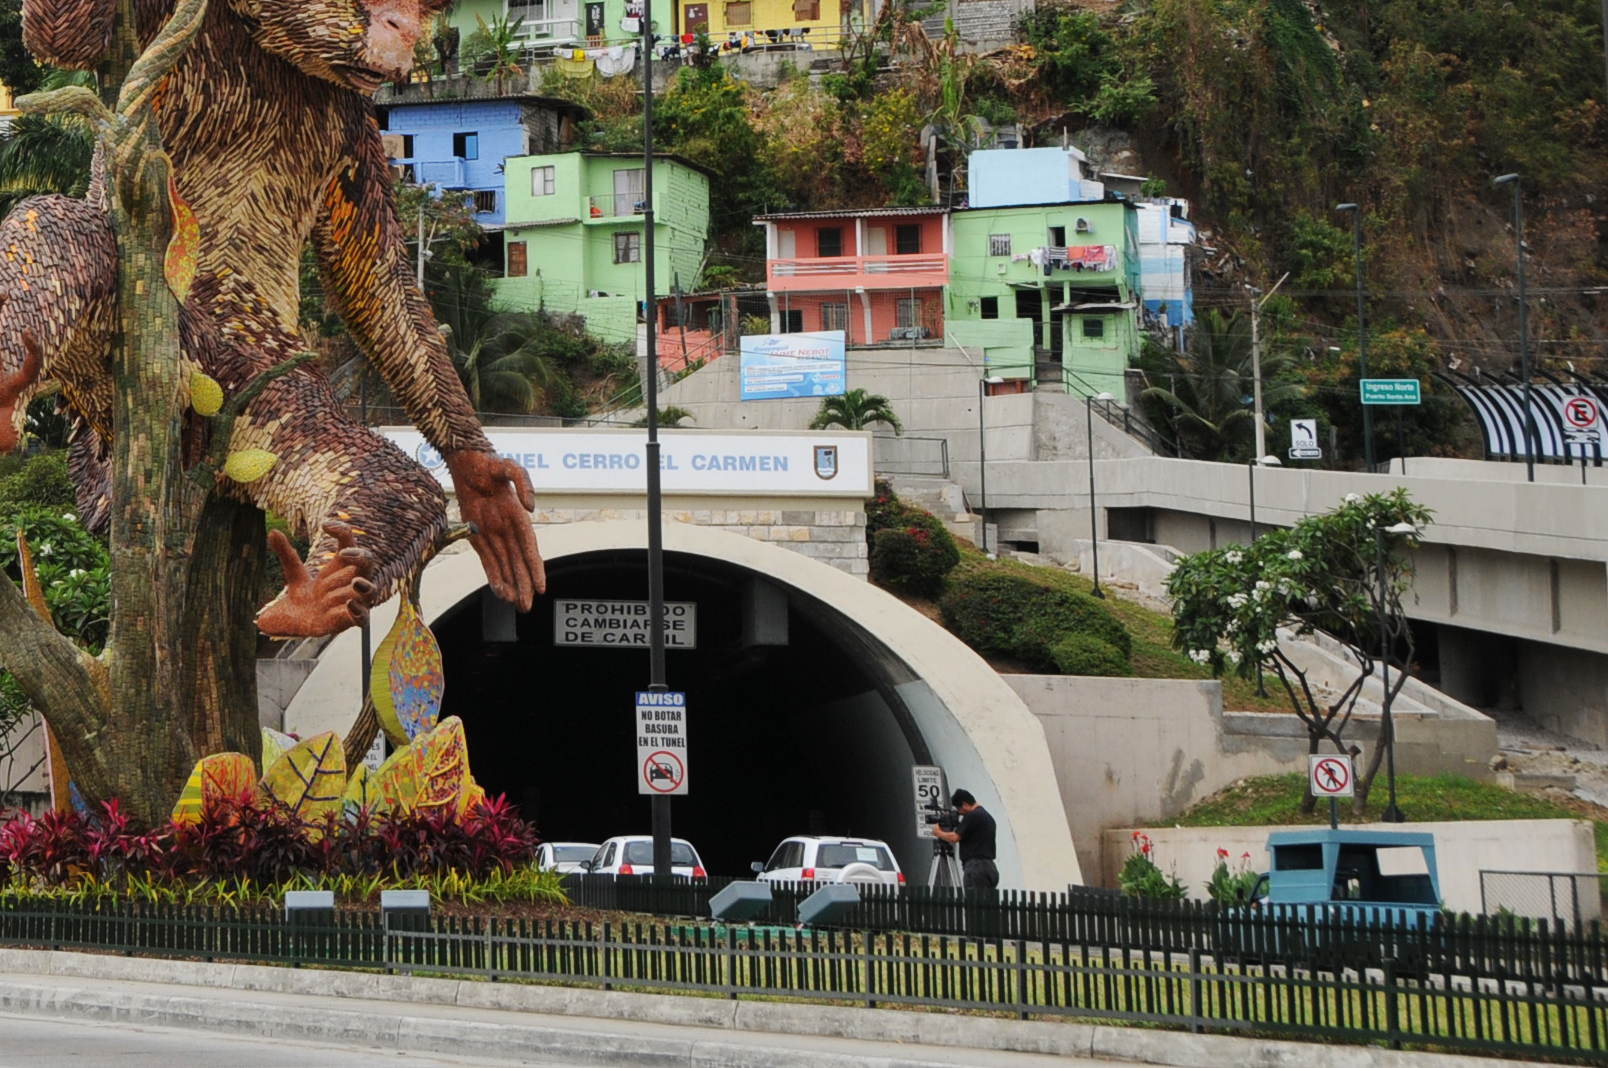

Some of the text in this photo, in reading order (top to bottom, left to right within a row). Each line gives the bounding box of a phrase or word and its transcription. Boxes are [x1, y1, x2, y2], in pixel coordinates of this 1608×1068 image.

[1365, 383, 1415, 392] Ingreso Norte
[562, 453, 640, 469] CERRO
[691, 454, 789, 471] CARMEN
[565, 603, 686, 617] PROHIBDO
[564, 631, 685, 645] DE CARIL
[638, 693, 684, 705] AVISO
[641, 710, 682, 721] NO BOTAR
[638, 736, 685, 748] EN EL TUNEL
[918, 784, 940, 798] 50
